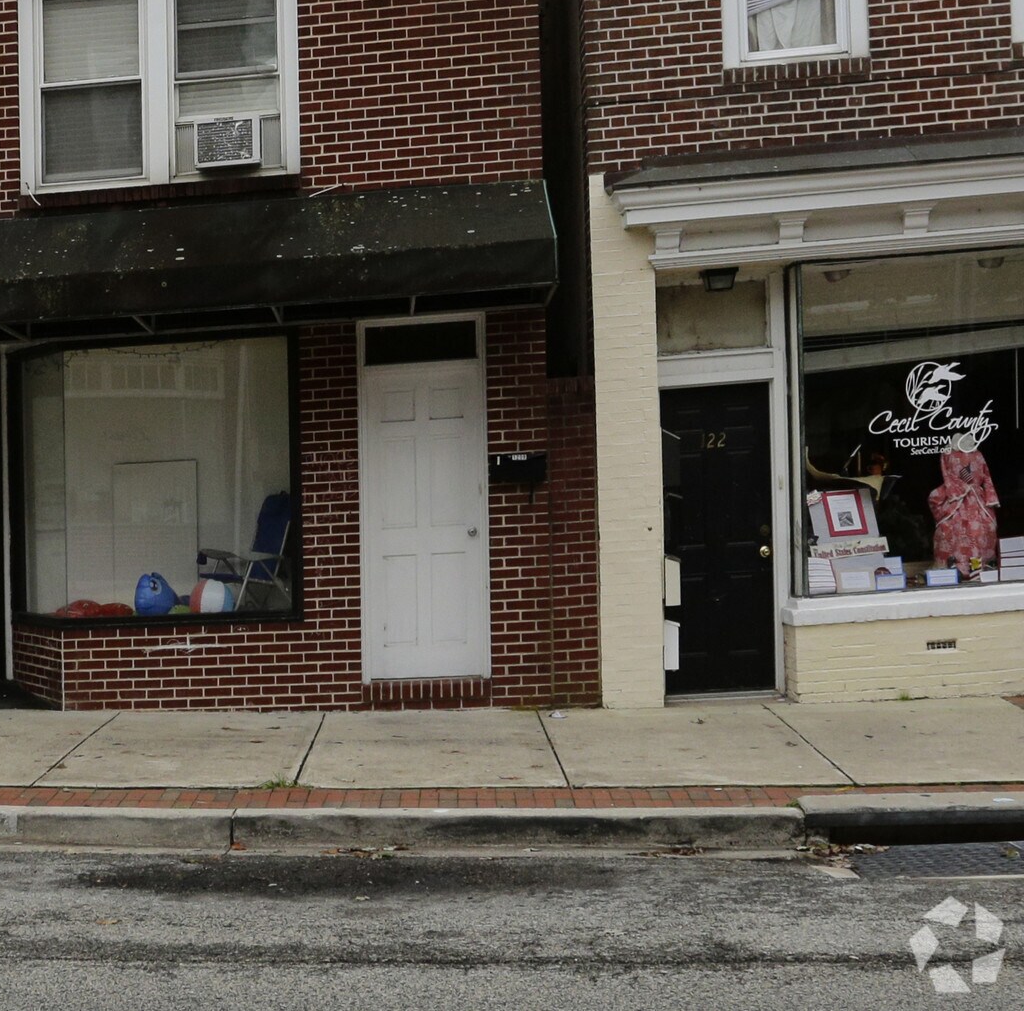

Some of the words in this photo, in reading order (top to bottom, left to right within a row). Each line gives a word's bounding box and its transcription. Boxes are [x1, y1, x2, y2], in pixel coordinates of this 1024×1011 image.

[868, 404, 920, 435] Cecil
[928, 399, 999, 453] County
[893, 435, 952, 448] TOURISM
